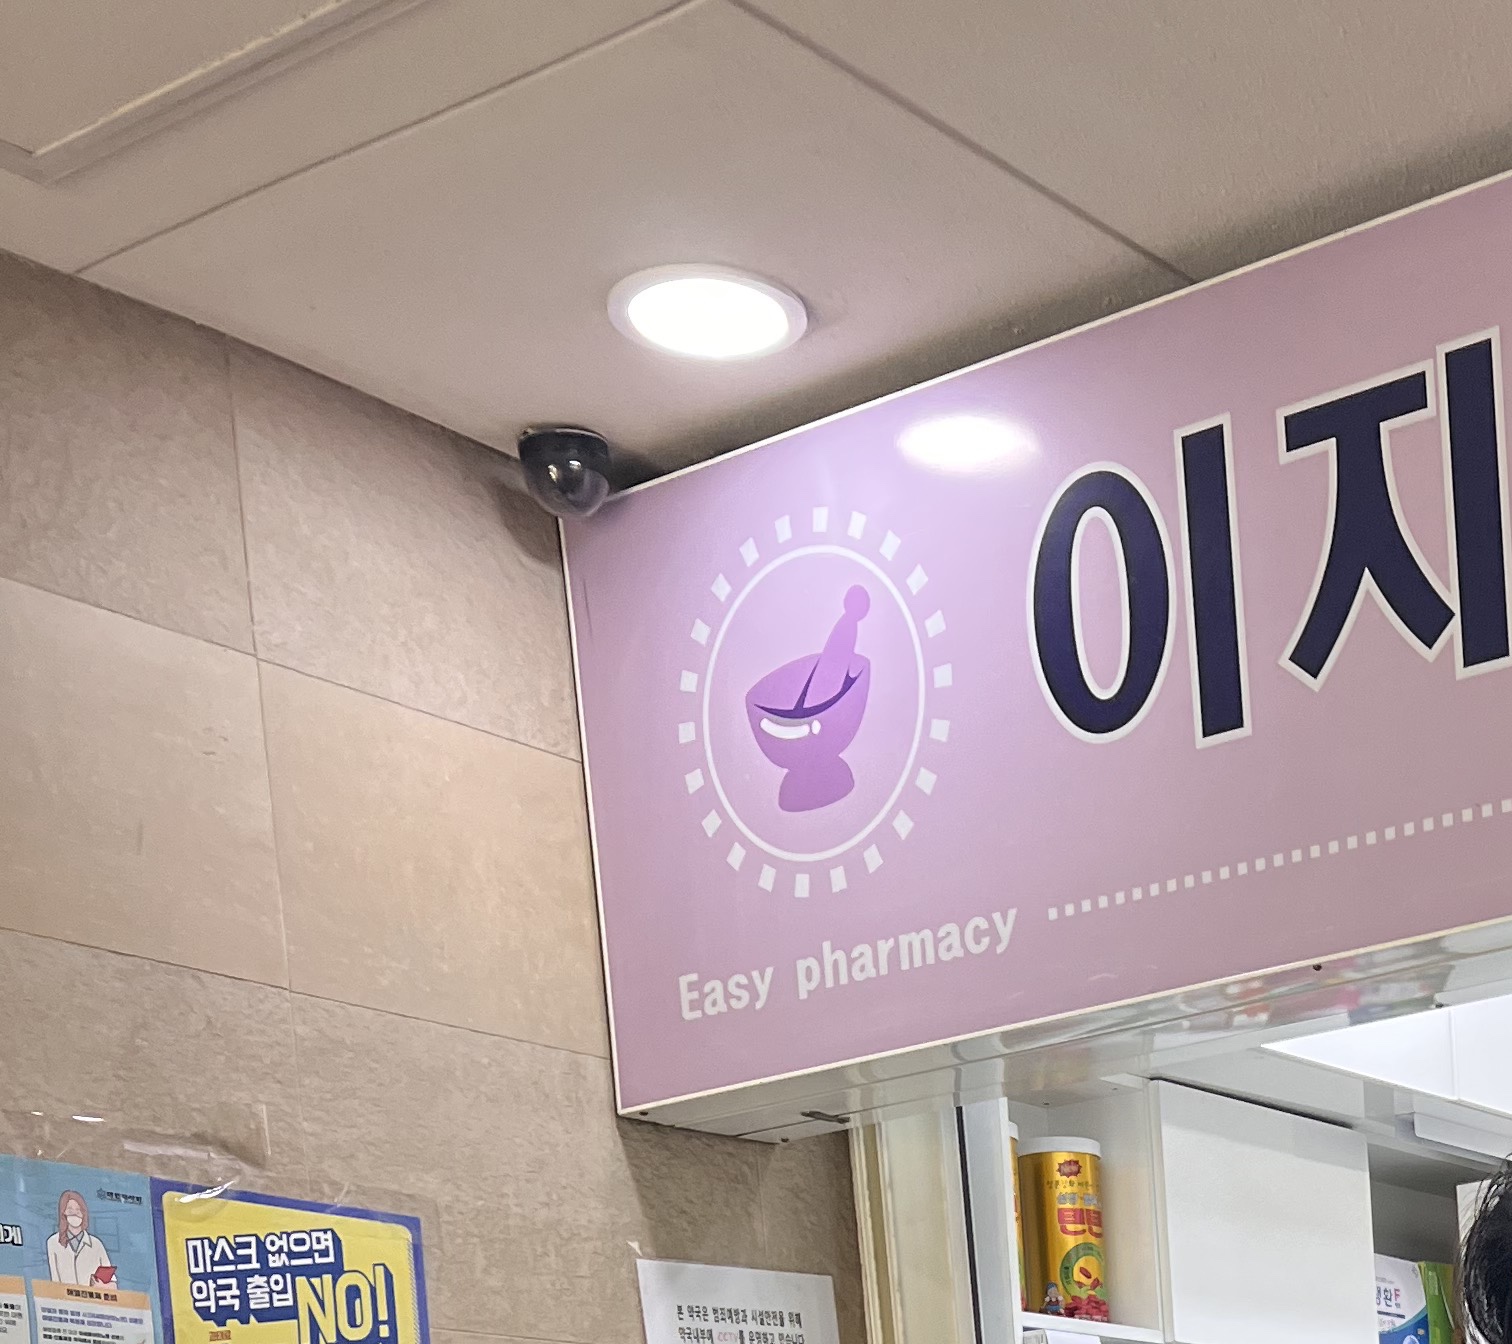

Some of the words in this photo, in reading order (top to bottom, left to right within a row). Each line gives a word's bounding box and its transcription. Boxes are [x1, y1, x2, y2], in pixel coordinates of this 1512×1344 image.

[678, 957, 775, 1025] Easy
[796, 905, 1019, 1003] pharmacy
[0, 1223, 22, 1245] 게
[186, 1234, 260, 1273] 마스크
[265, 1229, 335, 1267] 없으면
[191, 1277, 241, 1313] 약국
[247, 1273, 294, 1311] 출입
